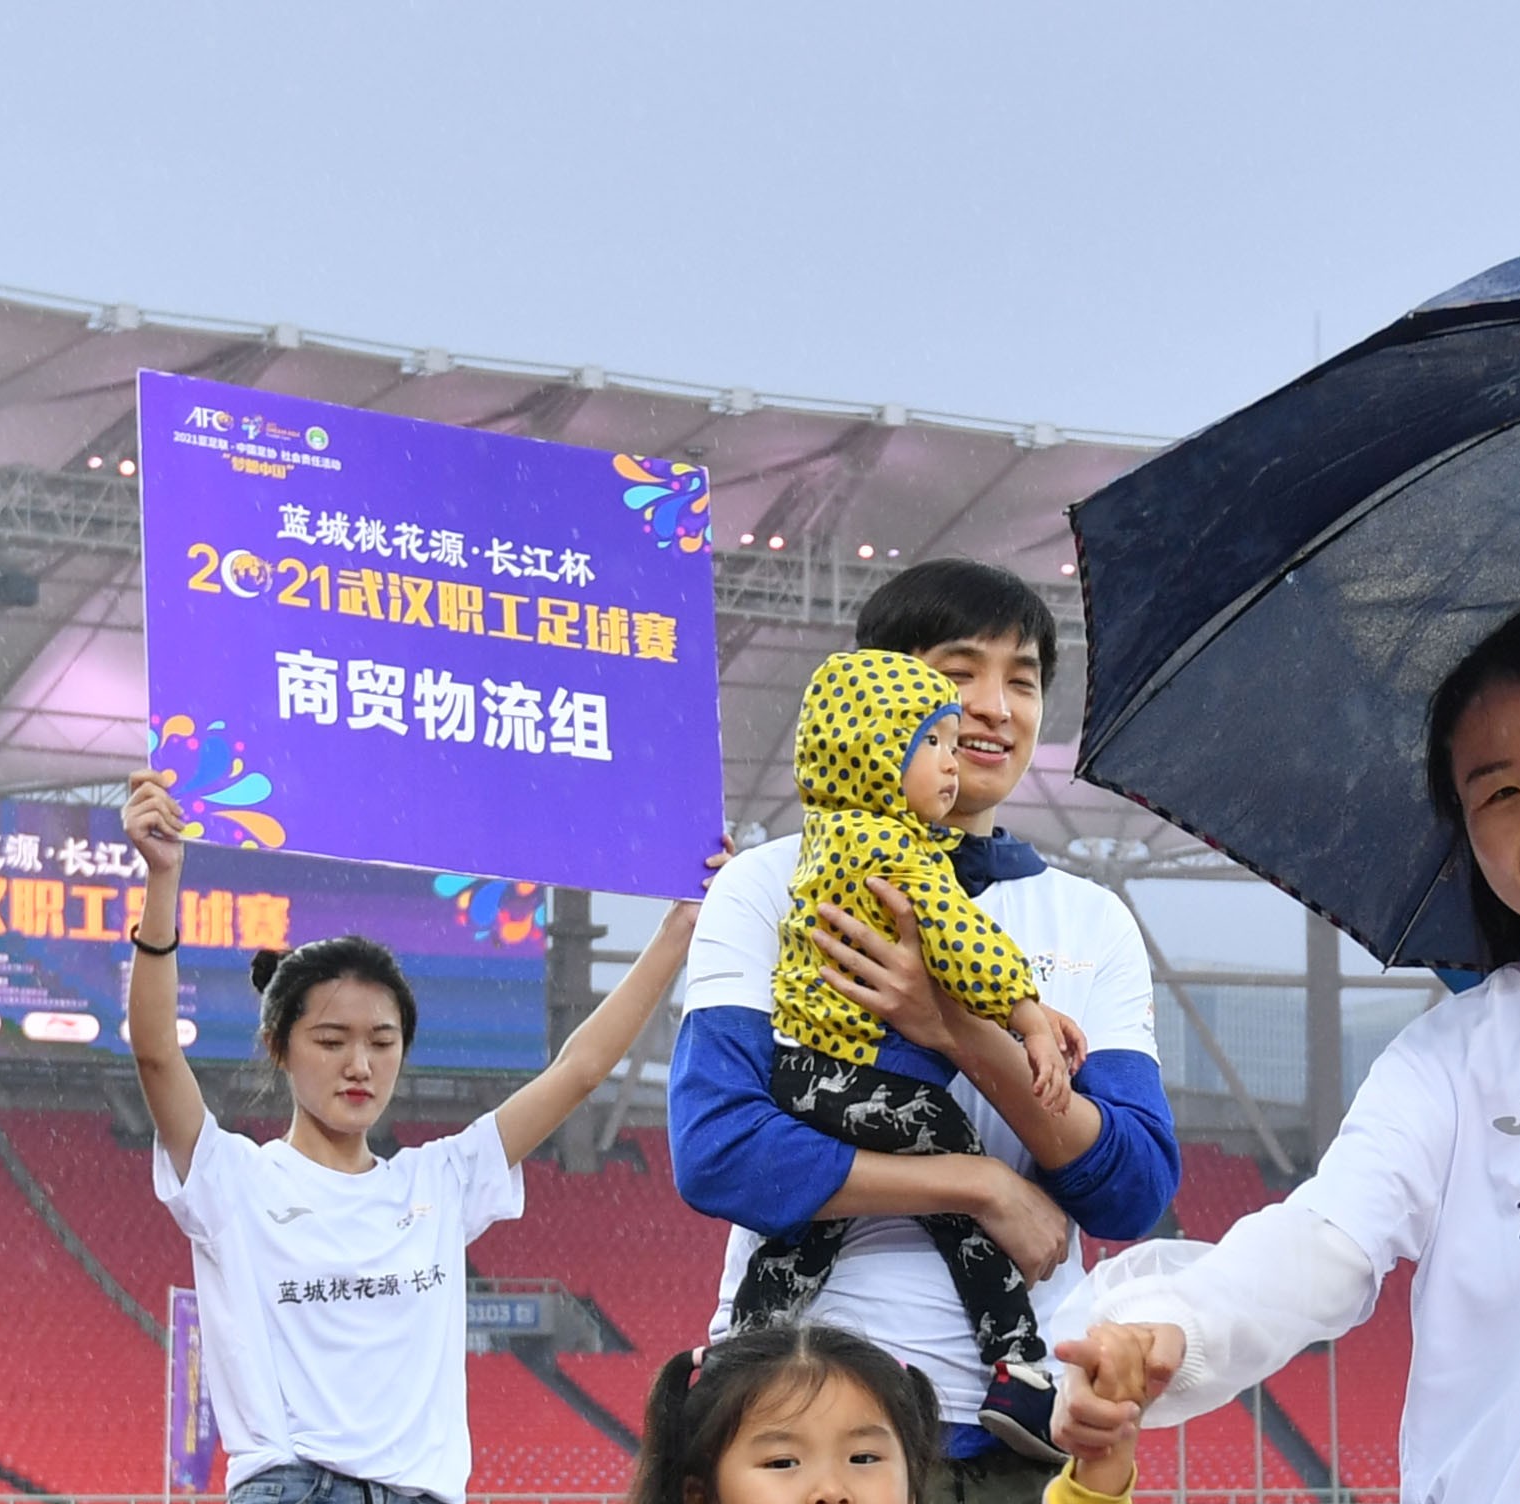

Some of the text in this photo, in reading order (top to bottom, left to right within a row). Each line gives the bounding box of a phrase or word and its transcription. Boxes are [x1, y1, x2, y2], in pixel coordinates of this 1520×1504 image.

[276, 504, 596, 587] 蓝城桃花源·长江杯
[186, 543, 679, 663] 2021武汉职工足球赛
[275, 649, 612, 761] 商贸物流组
[277, 1264, 446, 1305] 蓝城桃花源·长
